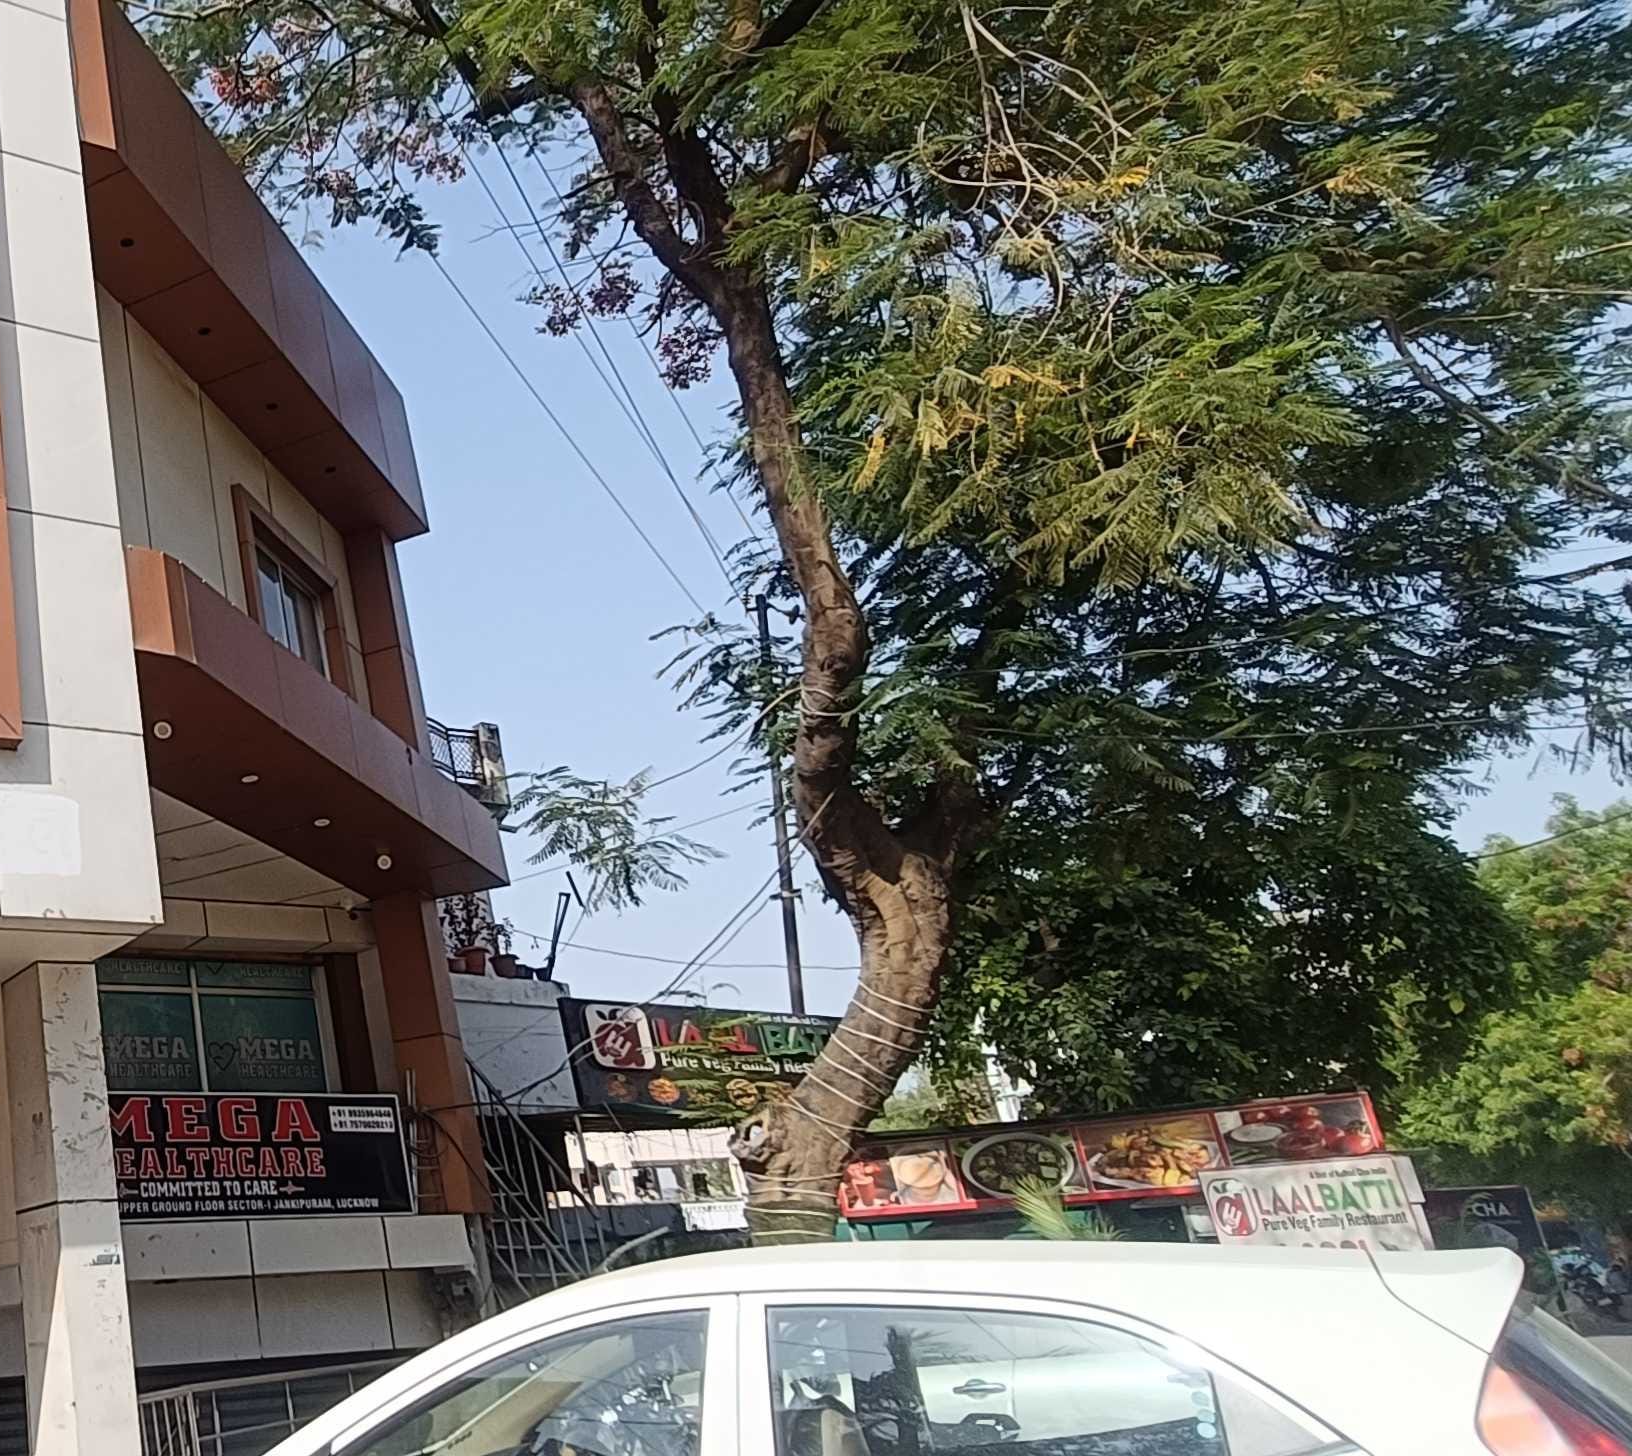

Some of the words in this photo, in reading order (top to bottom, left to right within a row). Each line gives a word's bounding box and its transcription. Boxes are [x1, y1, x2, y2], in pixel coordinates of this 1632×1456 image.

[106, 1035, 188, 1060] MEGA
[238, 1036, 317, 1061] MEGA
[240, 1063, 318, 1079] HEALTHCARE
[115, 1147, 326, 1179] EALTHCARE
[140, 1181, 220, 1198] COMMITTED
[223, 1181, 241, 1196] TO
[244, 1180, 278, 1196] CARE
[152, 1200, 192, 1212] GROUND
[195, 1200, 225, 1211] FLOOR
[273, 1198, 335, 1210] JANKIPURAM,
[337, 1197, 379, 1209] LUCKNOW
[1262, 1217, 1288, 1232] Pure
[1288, 1215, 1310, 1233] Veg
[1311, 1213, 1345, 1231] Family
[1347, 1210, 1409, 1227] Restaurant
